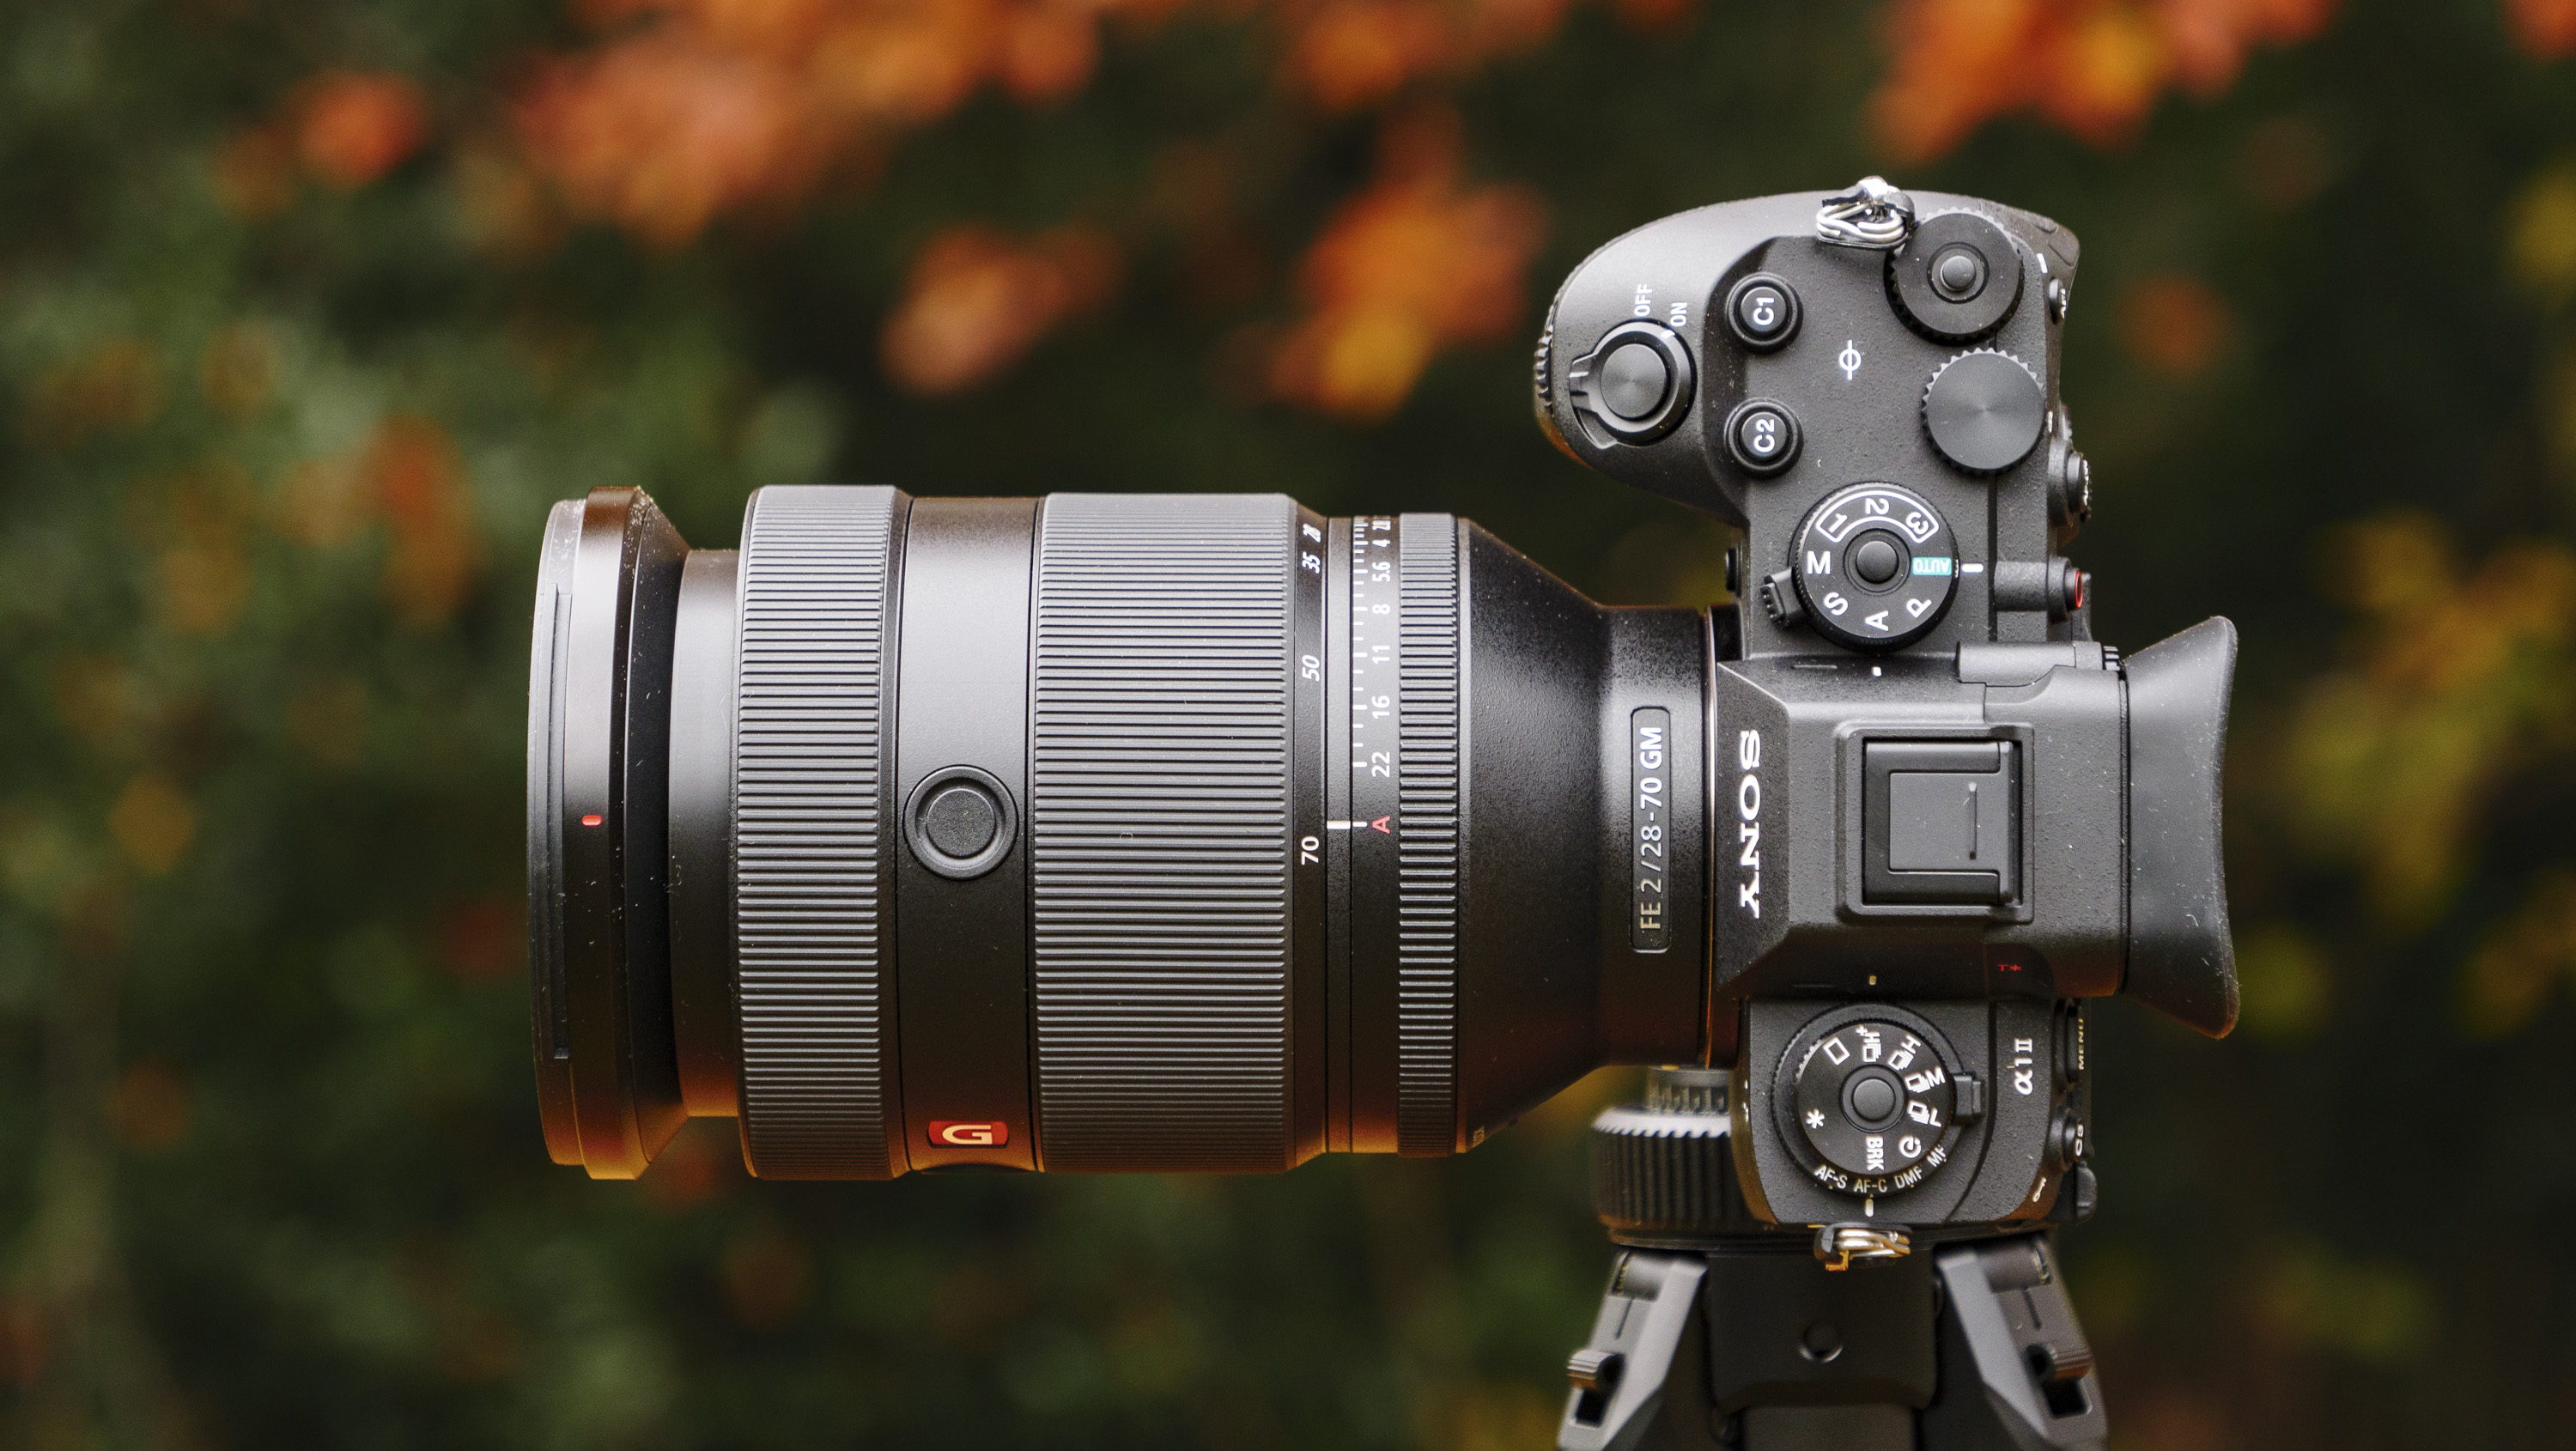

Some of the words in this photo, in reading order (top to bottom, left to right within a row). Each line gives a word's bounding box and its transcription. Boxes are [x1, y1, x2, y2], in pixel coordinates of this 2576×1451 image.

[1634, 283, 1653, 317] OFF
[1753, 296, 1775, 326] C1
[1670, 301, 1688, 327] ON
[1753, 417, 1775, 452] C2
[1865, 497, 1889, 515] 2
[1302, 522, 1321, 543] 28
[1829, 513, 1849, 532] 1
[1906, 511, 1929, 535] 3
[1371, 538, 1391, 548] 4
[1301, 550, 1321, 574] 35
[1371, 561, 1391, 582] 5.6
[1807, 550, 1831, 574] M
[1913, 559, 1950, 574] AUTO
[1371, 603, 1391, 615] 8
[1824, 592, 1848, 616] S
[1906, 598, 1932, 618] P
[1864, 610, 1889, 632] A
[1371, 644, 1391, 665] 11
[1301, 654, 1319, 682] 50
[1371, 695, 1391, 719] 16
[1639, 726, 1662, 770] GM
[1371, 750, 1391, 778] 22
[1370, 815, 1391, 834] A
[1739, 729, 1761, 919] SONY
[1302, 835, 1320, 865] 70
[1640, 902, 1662, 929] FE
[1902, 1034, 1922, 1055] H
[1924, 1065, 1947, 1088] M
[1929, 1107, 1942, 1127] L
[942, 1125, 993, 1145] G
[1865, 1135, 1886, 1172] BRK
[1927, 1144, 1947, 1168] MF
[1814, 1163, 1848, 1190] AF-S
[1853, 1177, 1888, 1194] AF-C
[1894, 1165, 1923, 1190] DMF
